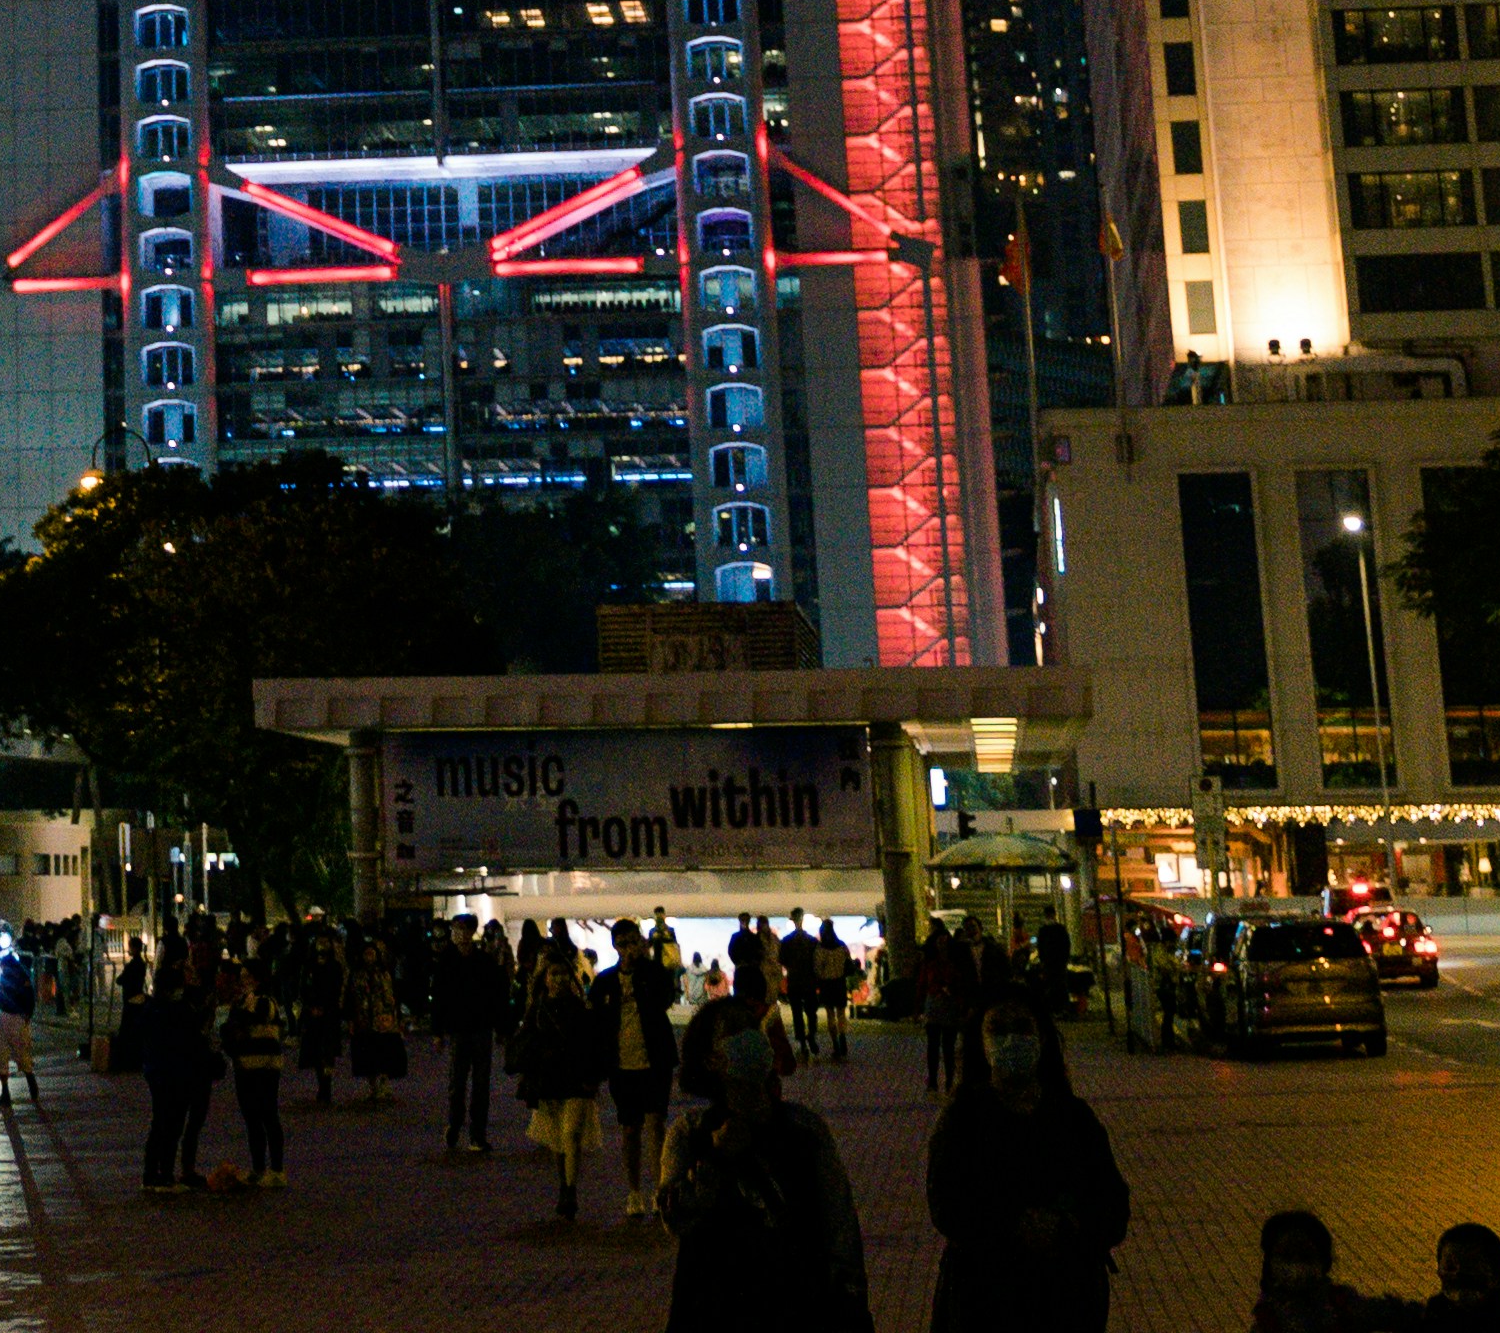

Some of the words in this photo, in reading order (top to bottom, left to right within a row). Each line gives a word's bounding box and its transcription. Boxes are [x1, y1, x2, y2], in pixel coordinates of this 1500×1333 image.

[435, 739, 565, 797] music
[670, 768, 819, 828] within
[554, 798, 669, 860] from
